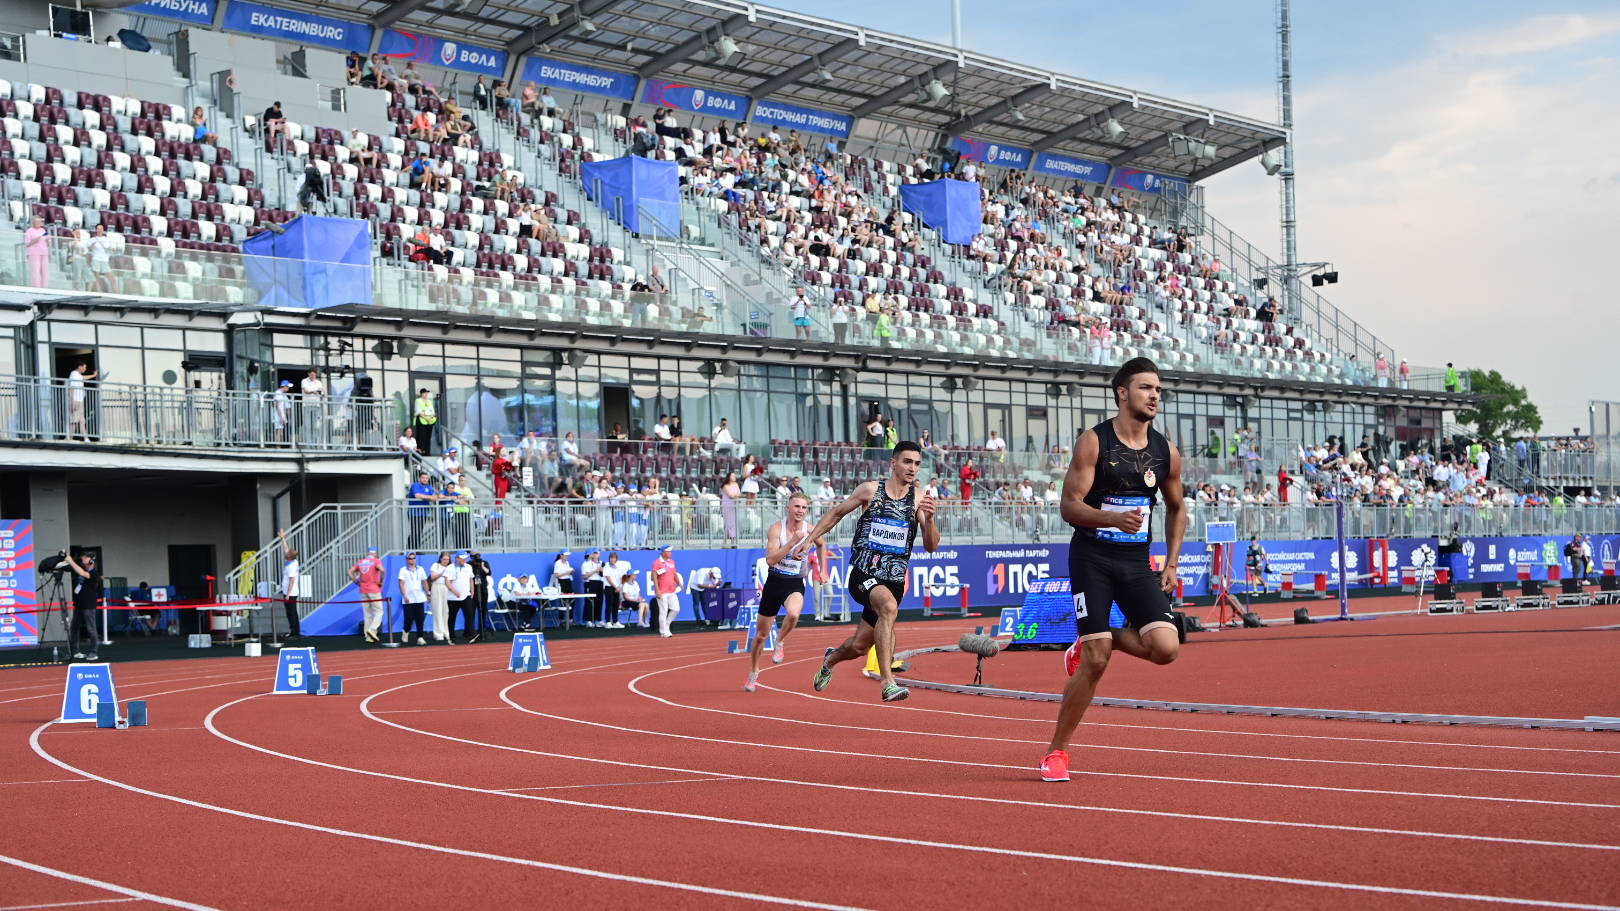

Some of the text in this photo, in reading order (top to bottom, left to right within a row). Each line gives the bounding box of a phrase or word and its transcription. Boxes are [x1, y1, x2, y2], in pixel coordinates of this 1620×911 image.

[145, 0, 208, 16] РИБУНА
[250, 12, 344, 40] EKATERINBURG
[460, 49, 497, 68] ВФЛА
[540, 65, 615, 89] ЕКАТЕРИНБУРГ
[707, 96, 736, 111] ВФЛА
[755, 105, 847, 132] ВОСТОЧНАЯ ТРИБУНА
[999, 150, 1022, 163] ВФЛА
[1044, 158, 1094, 176] ЕКАТЕРИНБУРГ
[872, 528, 905, 541] ВАРДИКОВ
[985, 548, 1050, 559] ГЕНЕРАЛЬНЫЙ ПАРТНЁР
[1517, 548, 1538, 561] azimut
[913, 565, 960, 597] ПСБ
[1076, 597, 1084, 614] 4
[1005, 617, 1014, 631] 2
[1014, 622, 1039, 641] 3.6
[288, 663, 303, 688] 5
[80, 683, 99, 715] 6
